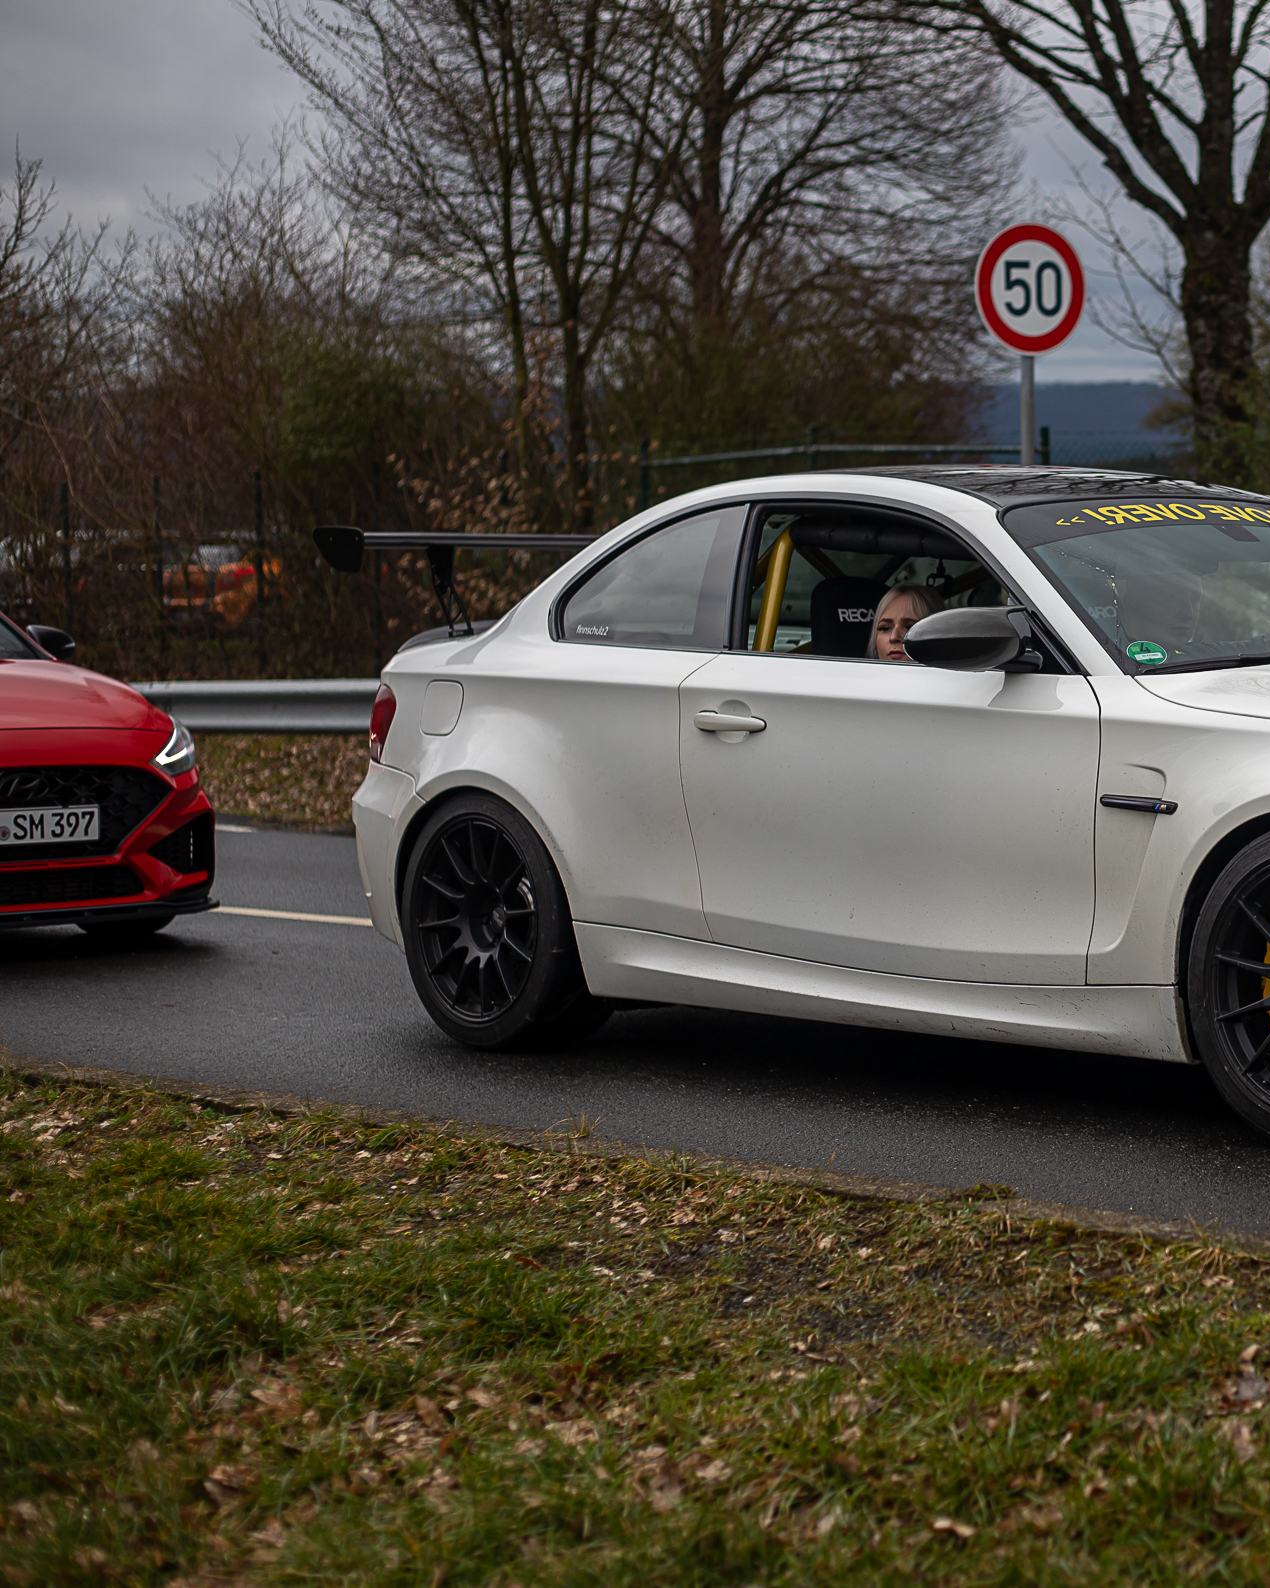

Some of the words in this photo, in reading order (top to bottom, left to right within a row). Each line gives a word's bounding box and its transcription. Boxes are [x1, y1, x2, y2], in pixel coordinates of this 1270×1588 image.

[1004, 260, 1062, 317] 50
[838, 608, 876, 622] RECA
[12, 813, 45, 840] SM
[50, 810, 95, 838] 397
